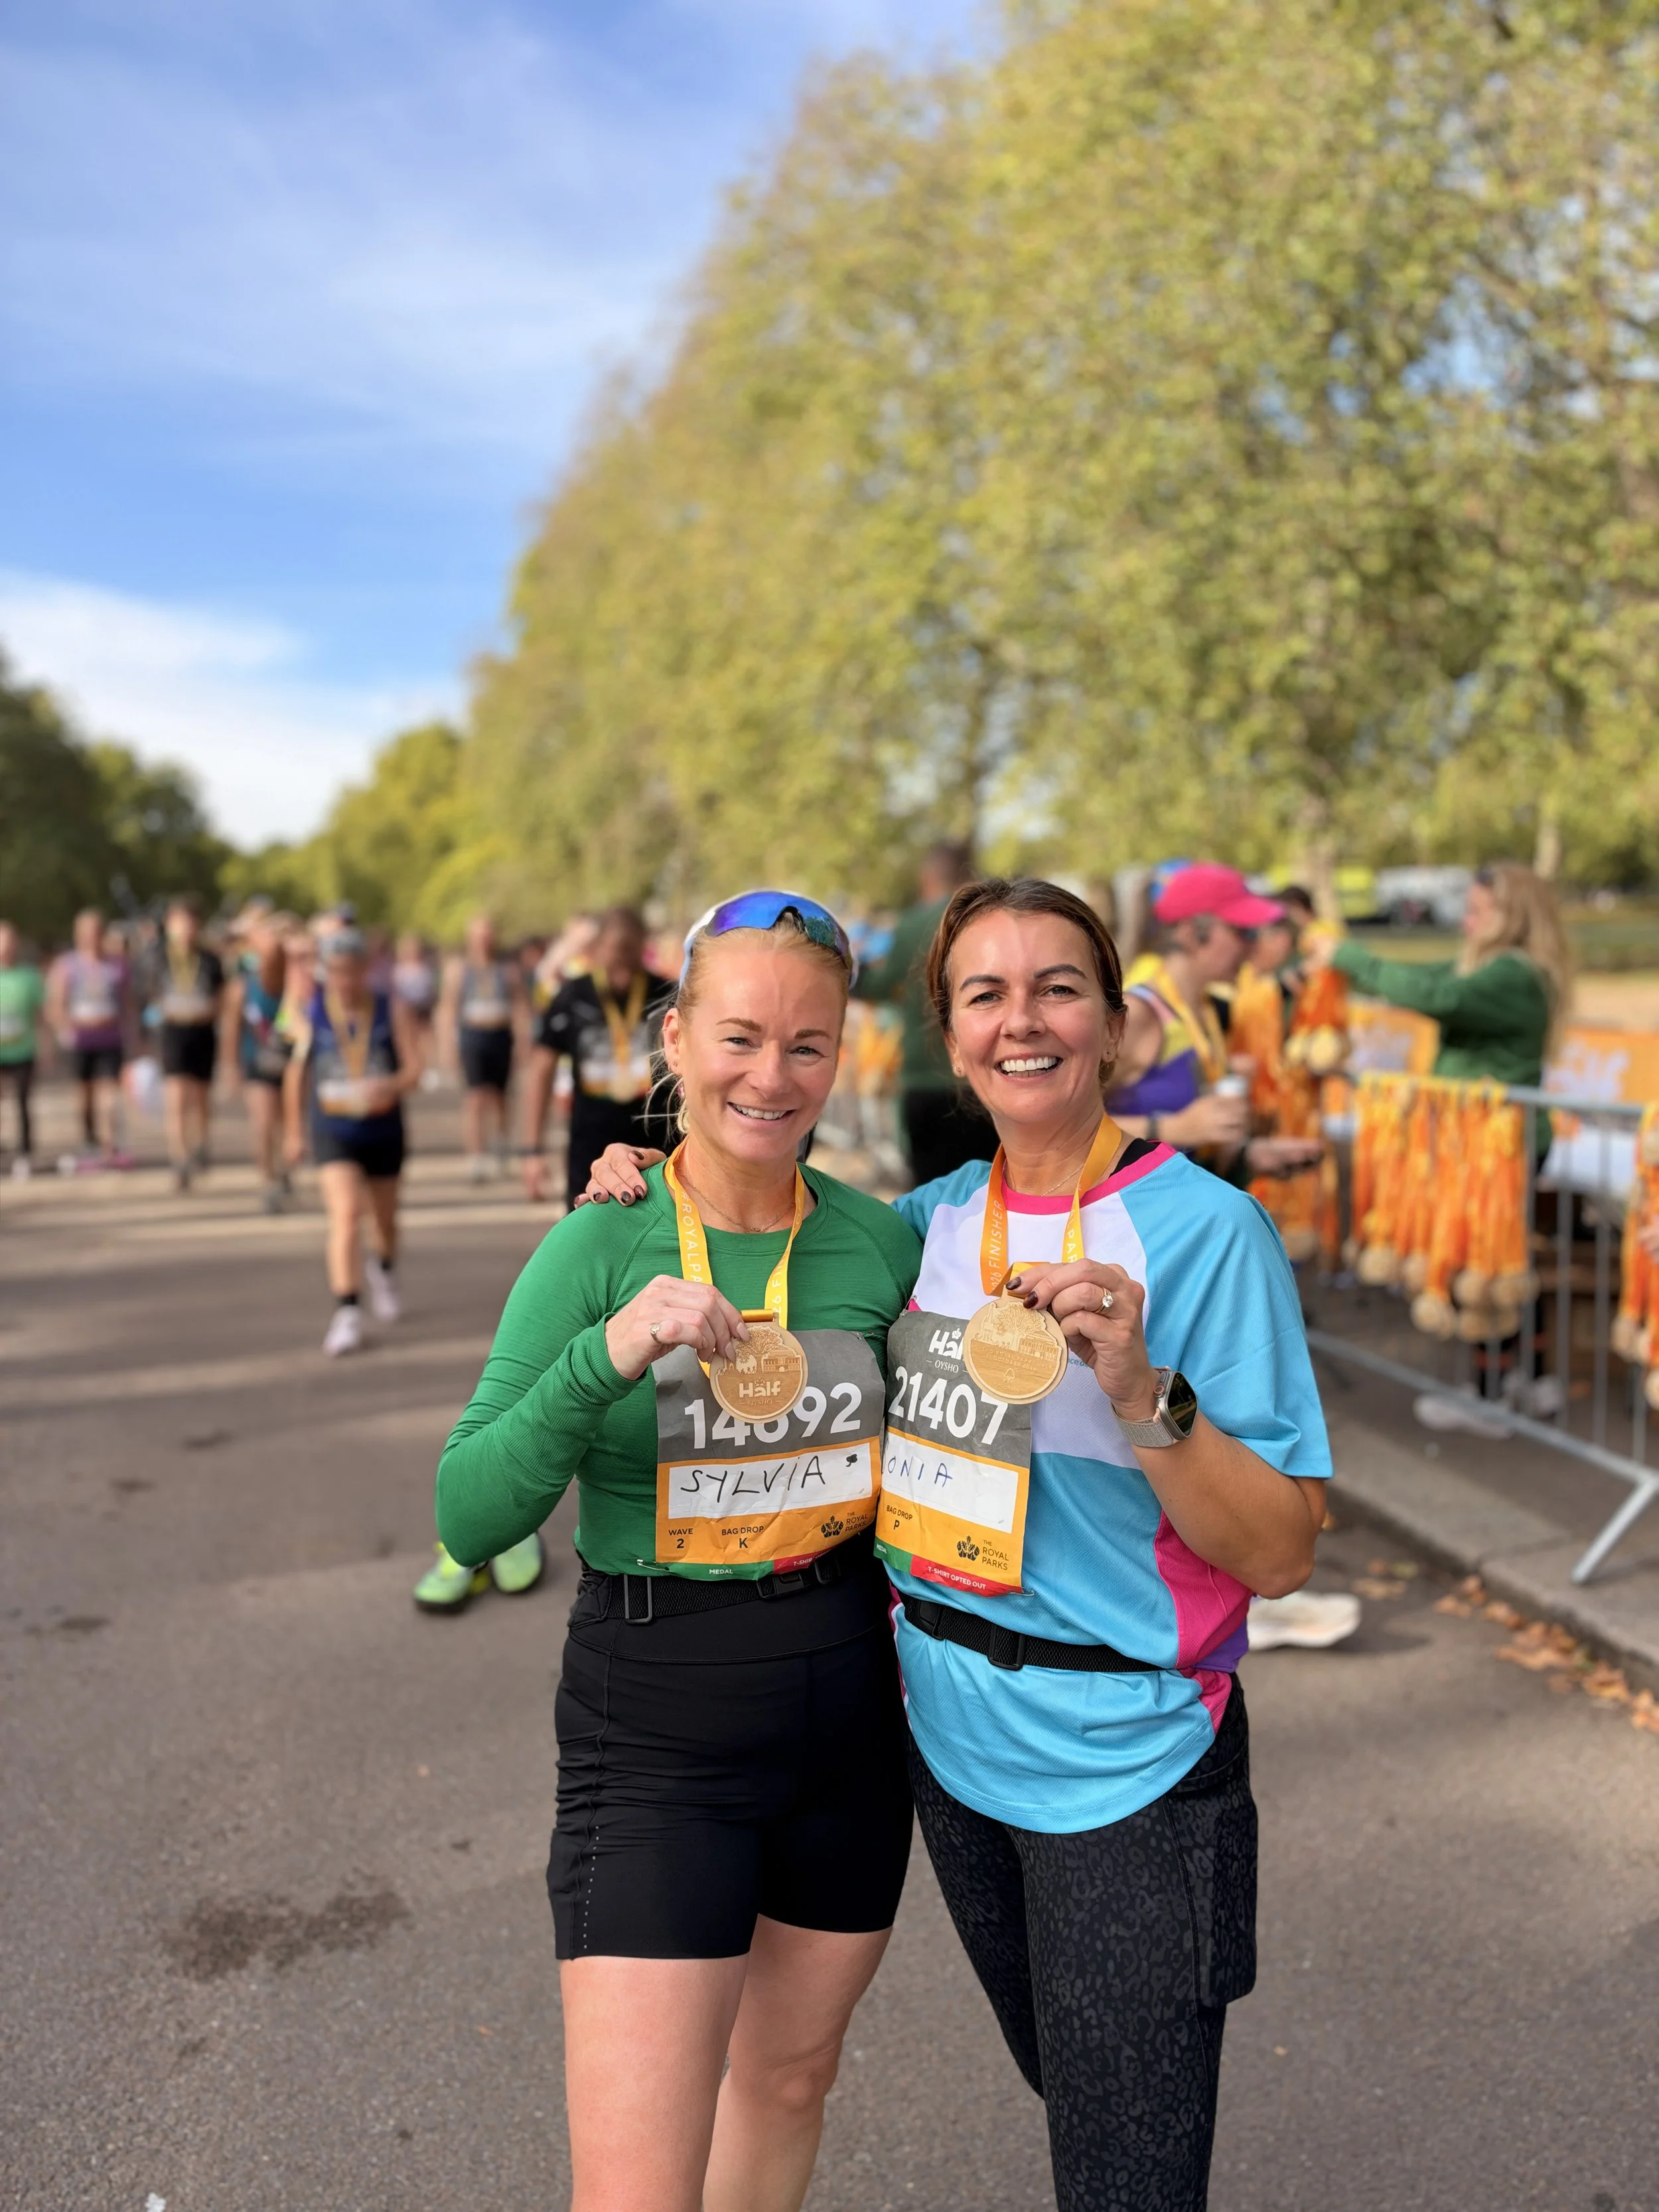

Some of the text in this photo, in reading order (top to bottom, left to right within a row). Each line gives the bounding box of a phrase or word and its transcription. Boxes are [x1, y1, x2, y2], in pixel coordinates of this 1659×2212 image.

[988, 1201, 1003, 1269] FINISHER
[928, 1329, 965, 1361] Hal
[935, 1360, 959, 1373] OYSHO
[739, 1380, 781, 1398] Half
[888, 1366, 1008, 1445] 21407
[882, 1455, 953, 1487] ONIA
[846, 1513, 869, 1525] ROYAL
[886, 1505, 913, 1520] BAG DROP
[741, 1525, 764, 1534] DROP
[845, 1521, 866, 1533] PARKS
[893, 1519, 901, 1530] P
[676, 1538, 685, 1549] 2
[739, 1537, 749, 1548] K
[793, 1556, 814, 1566] T-SHIR
[982, 1546, 1009, 1562] ROYAL
[982, 1556, 1008, 1571] PARKS
[928, 1566, 986, 1589] T-SHIRT OPTED OUT
